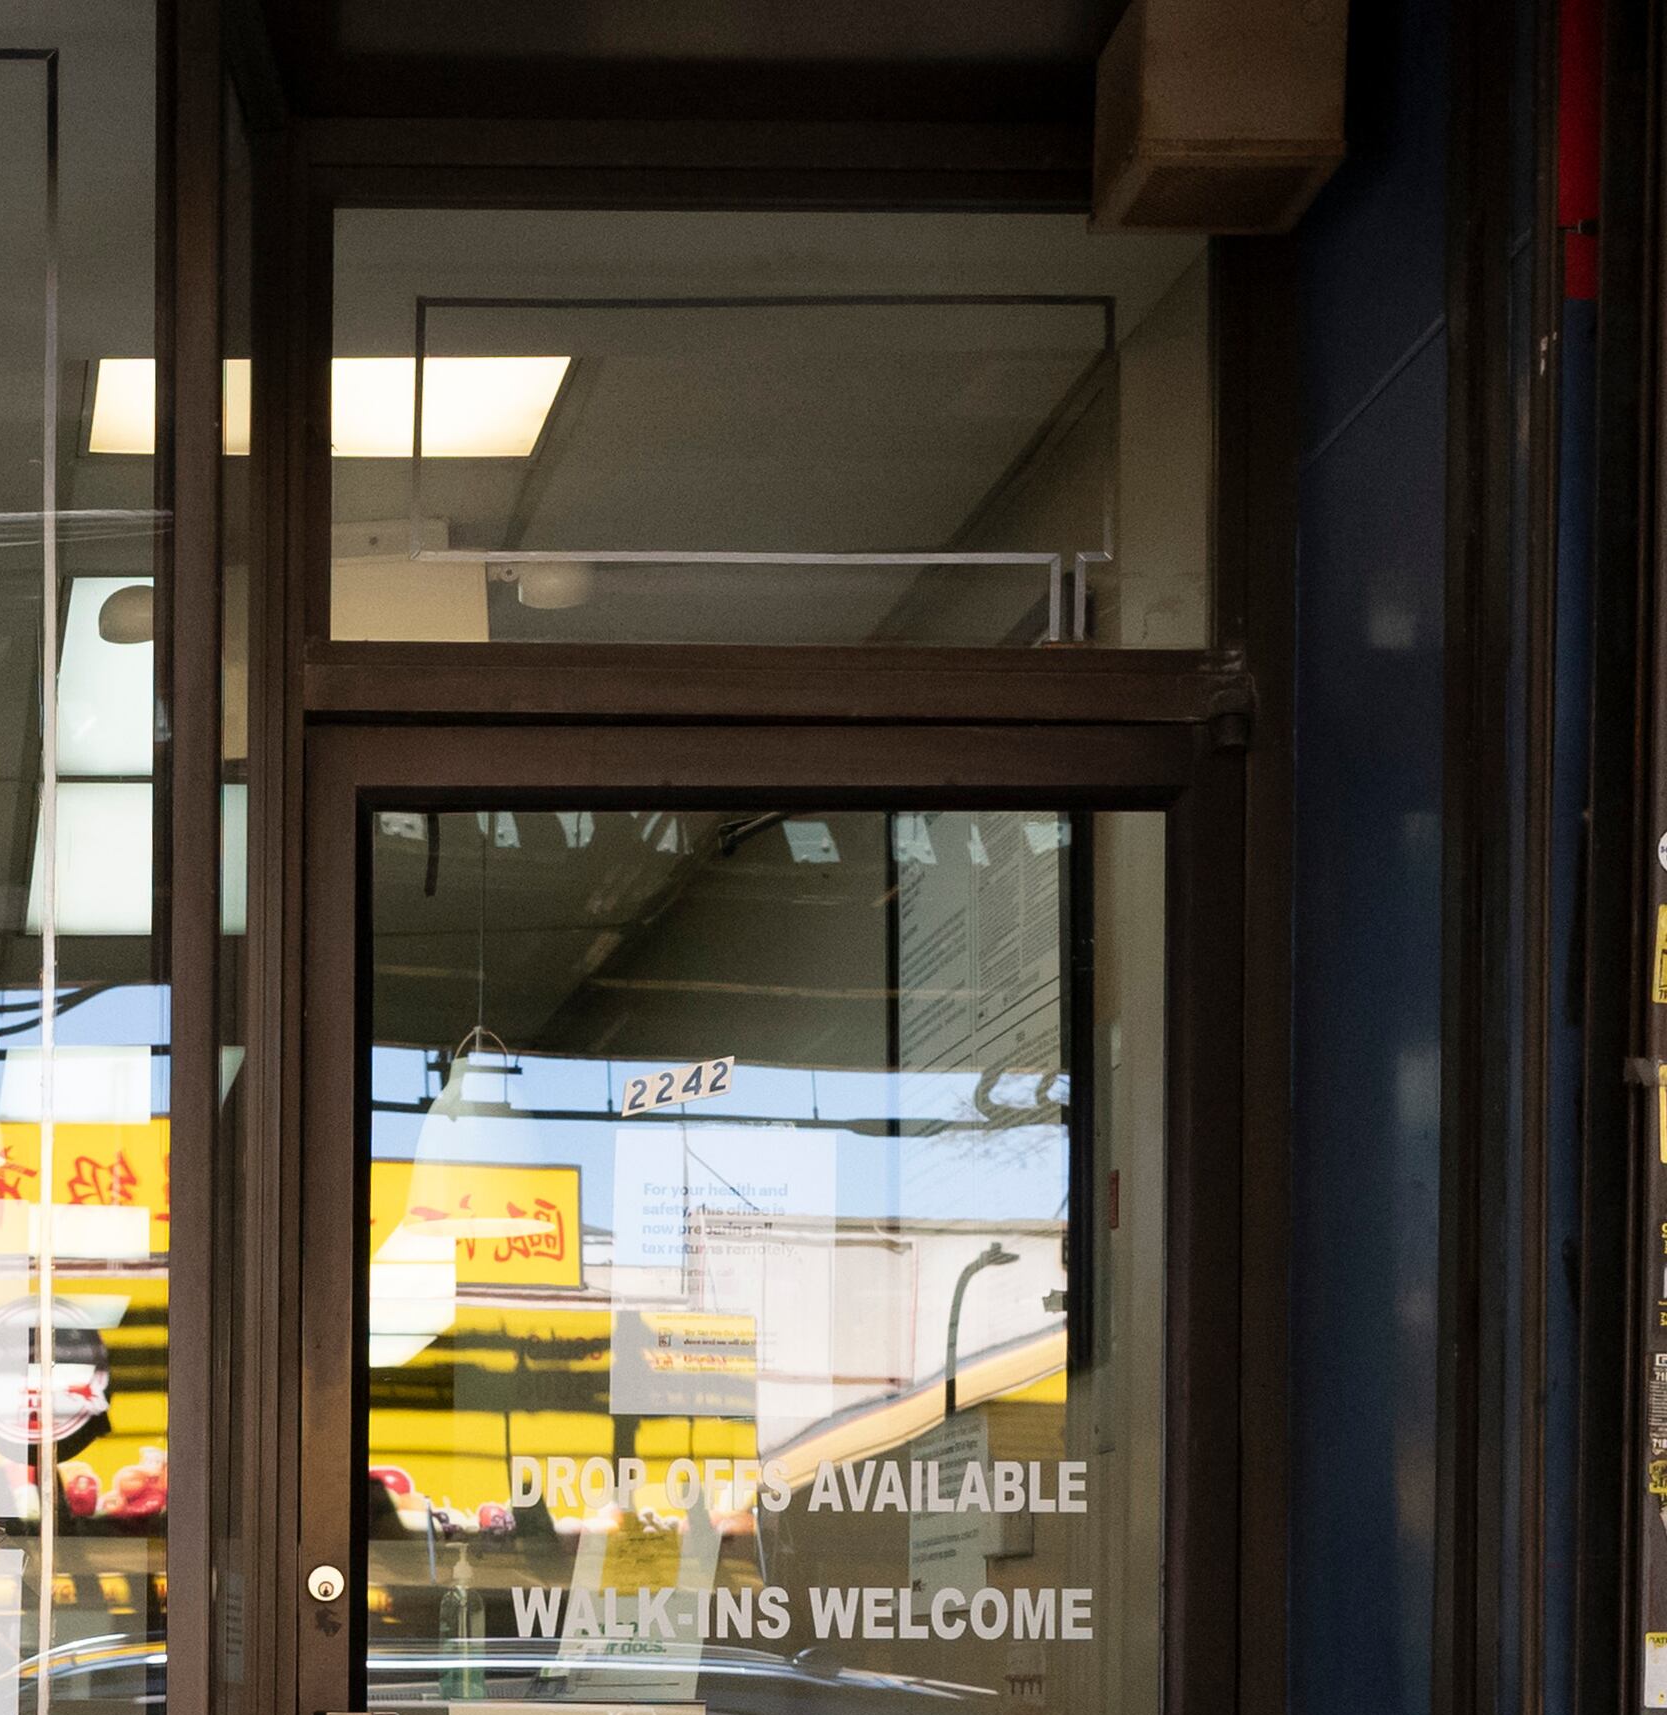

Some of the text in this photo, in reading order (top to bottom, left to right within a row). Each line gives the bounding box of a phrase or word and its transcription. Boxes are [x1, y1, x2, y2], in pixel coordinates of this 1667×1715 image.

[631, 1060, 730, 1109] 2242
[643, 1184, 668, 1196] For
[671, 1186, 704, 1199] your
[760, 1184, 788, 1196] and
[642, 1225, 674, 1235] now
[642, 1244, 665, 1254] tax
[511, 1456, 1088, 1512] DROP OFFS AVAILABLE
[511, 1586, 791, 1640] WALK-INS
[810, 1587, 1094, 1640] WELCOME
